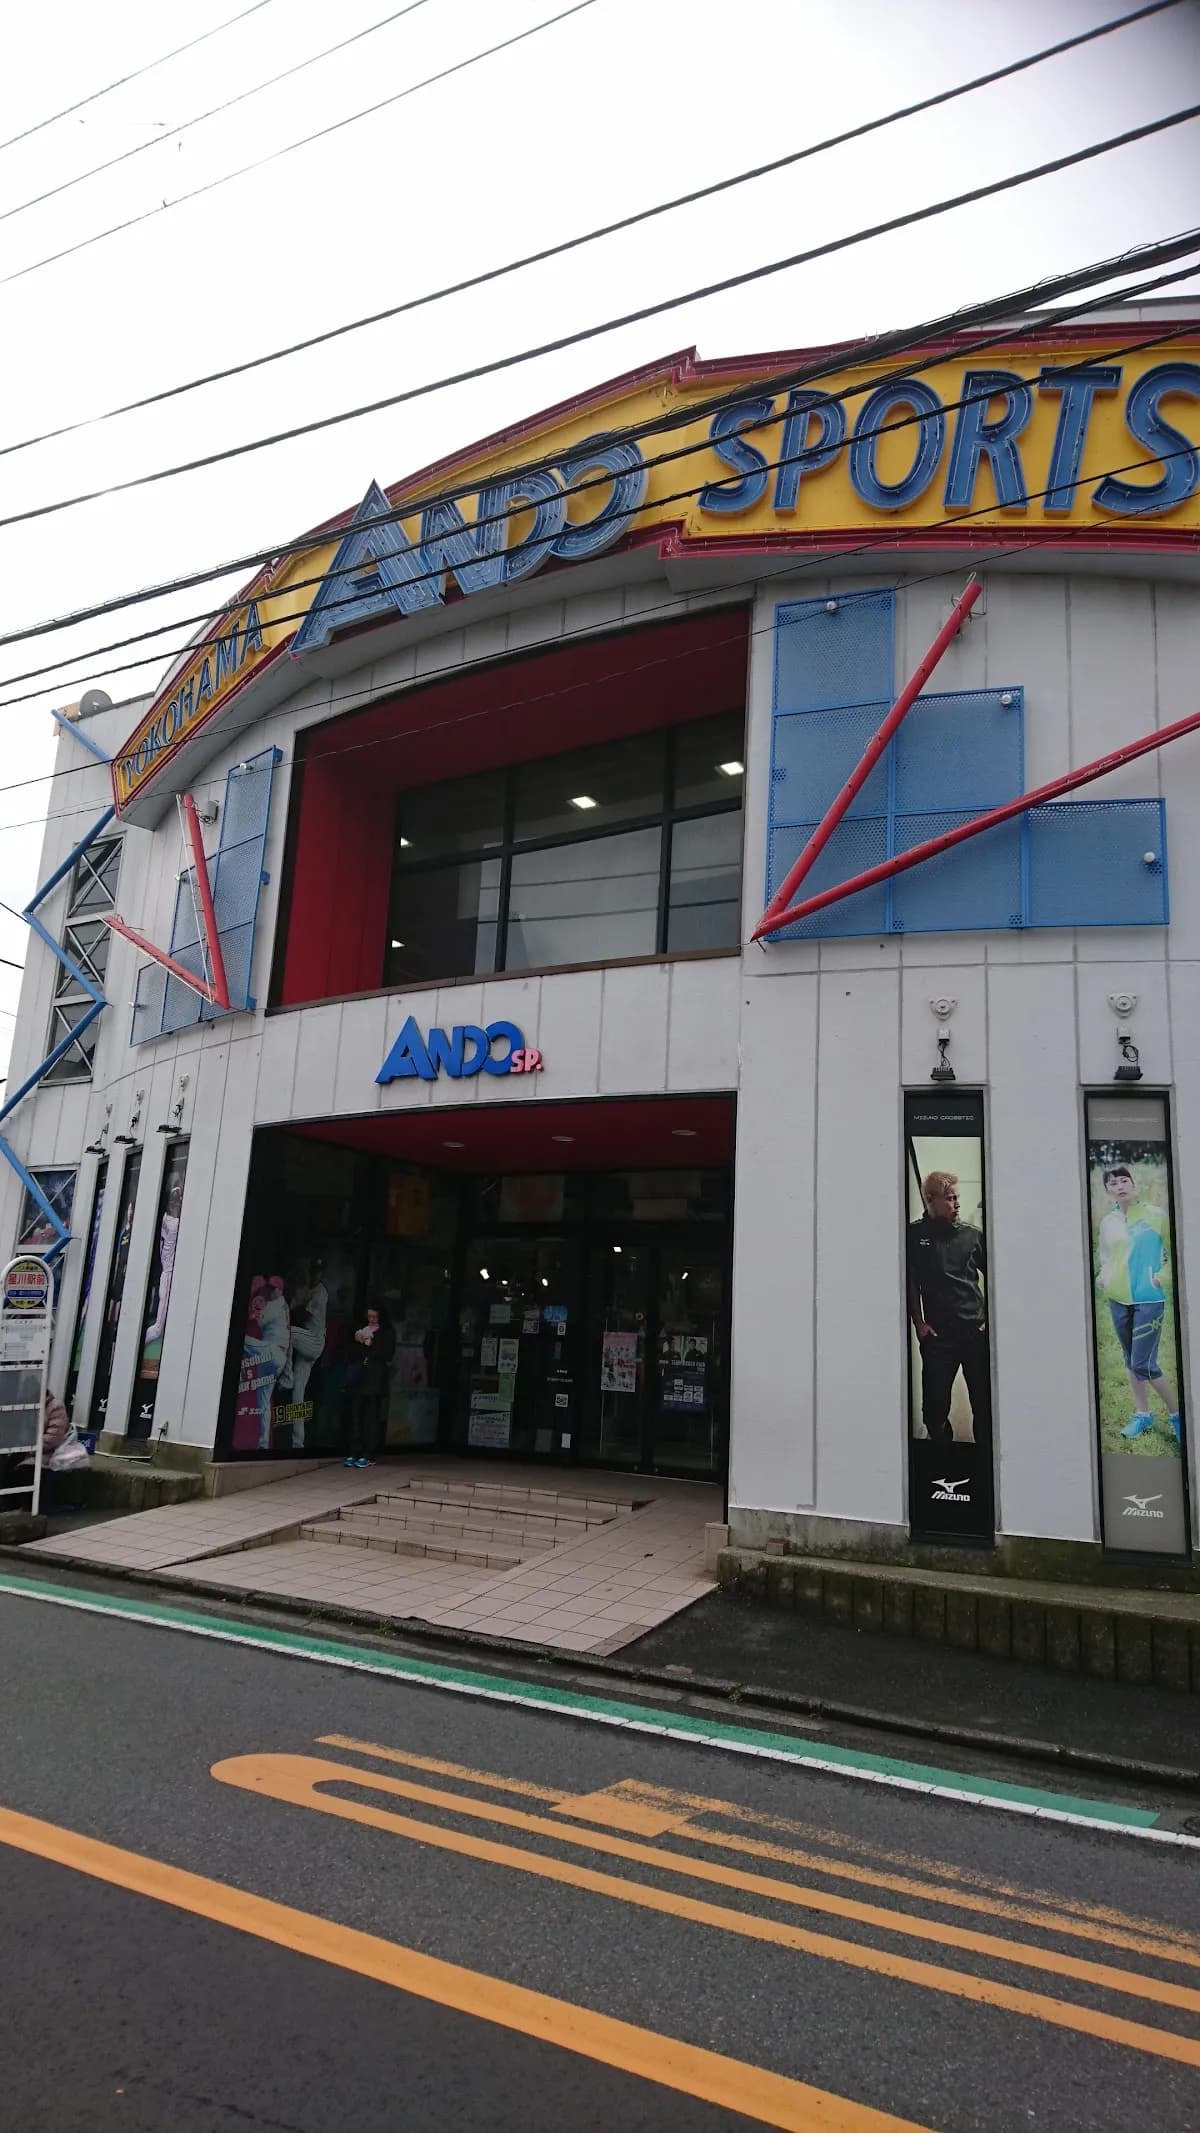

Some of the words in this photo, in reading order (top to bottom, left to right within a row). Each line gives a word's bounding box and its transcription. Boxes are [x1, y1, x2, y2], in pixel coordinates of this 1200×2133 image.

[121, 602, 265, 790] YOKOHAMA
[288, 432, 650, 656] ANDO
[697, 362, 1200, 517] SPORTS
[375, 1015, 525, 1085] ANDO
[8, 1273, 45, 1286] 星川駅前
[241, 1351, 272, 1369] aseball
[273, 1406, 284, 1423] 19
[930, 1489, 971, 1502] MIZUNO
[1121, 1505, 1164, 1519] MIZUNO
